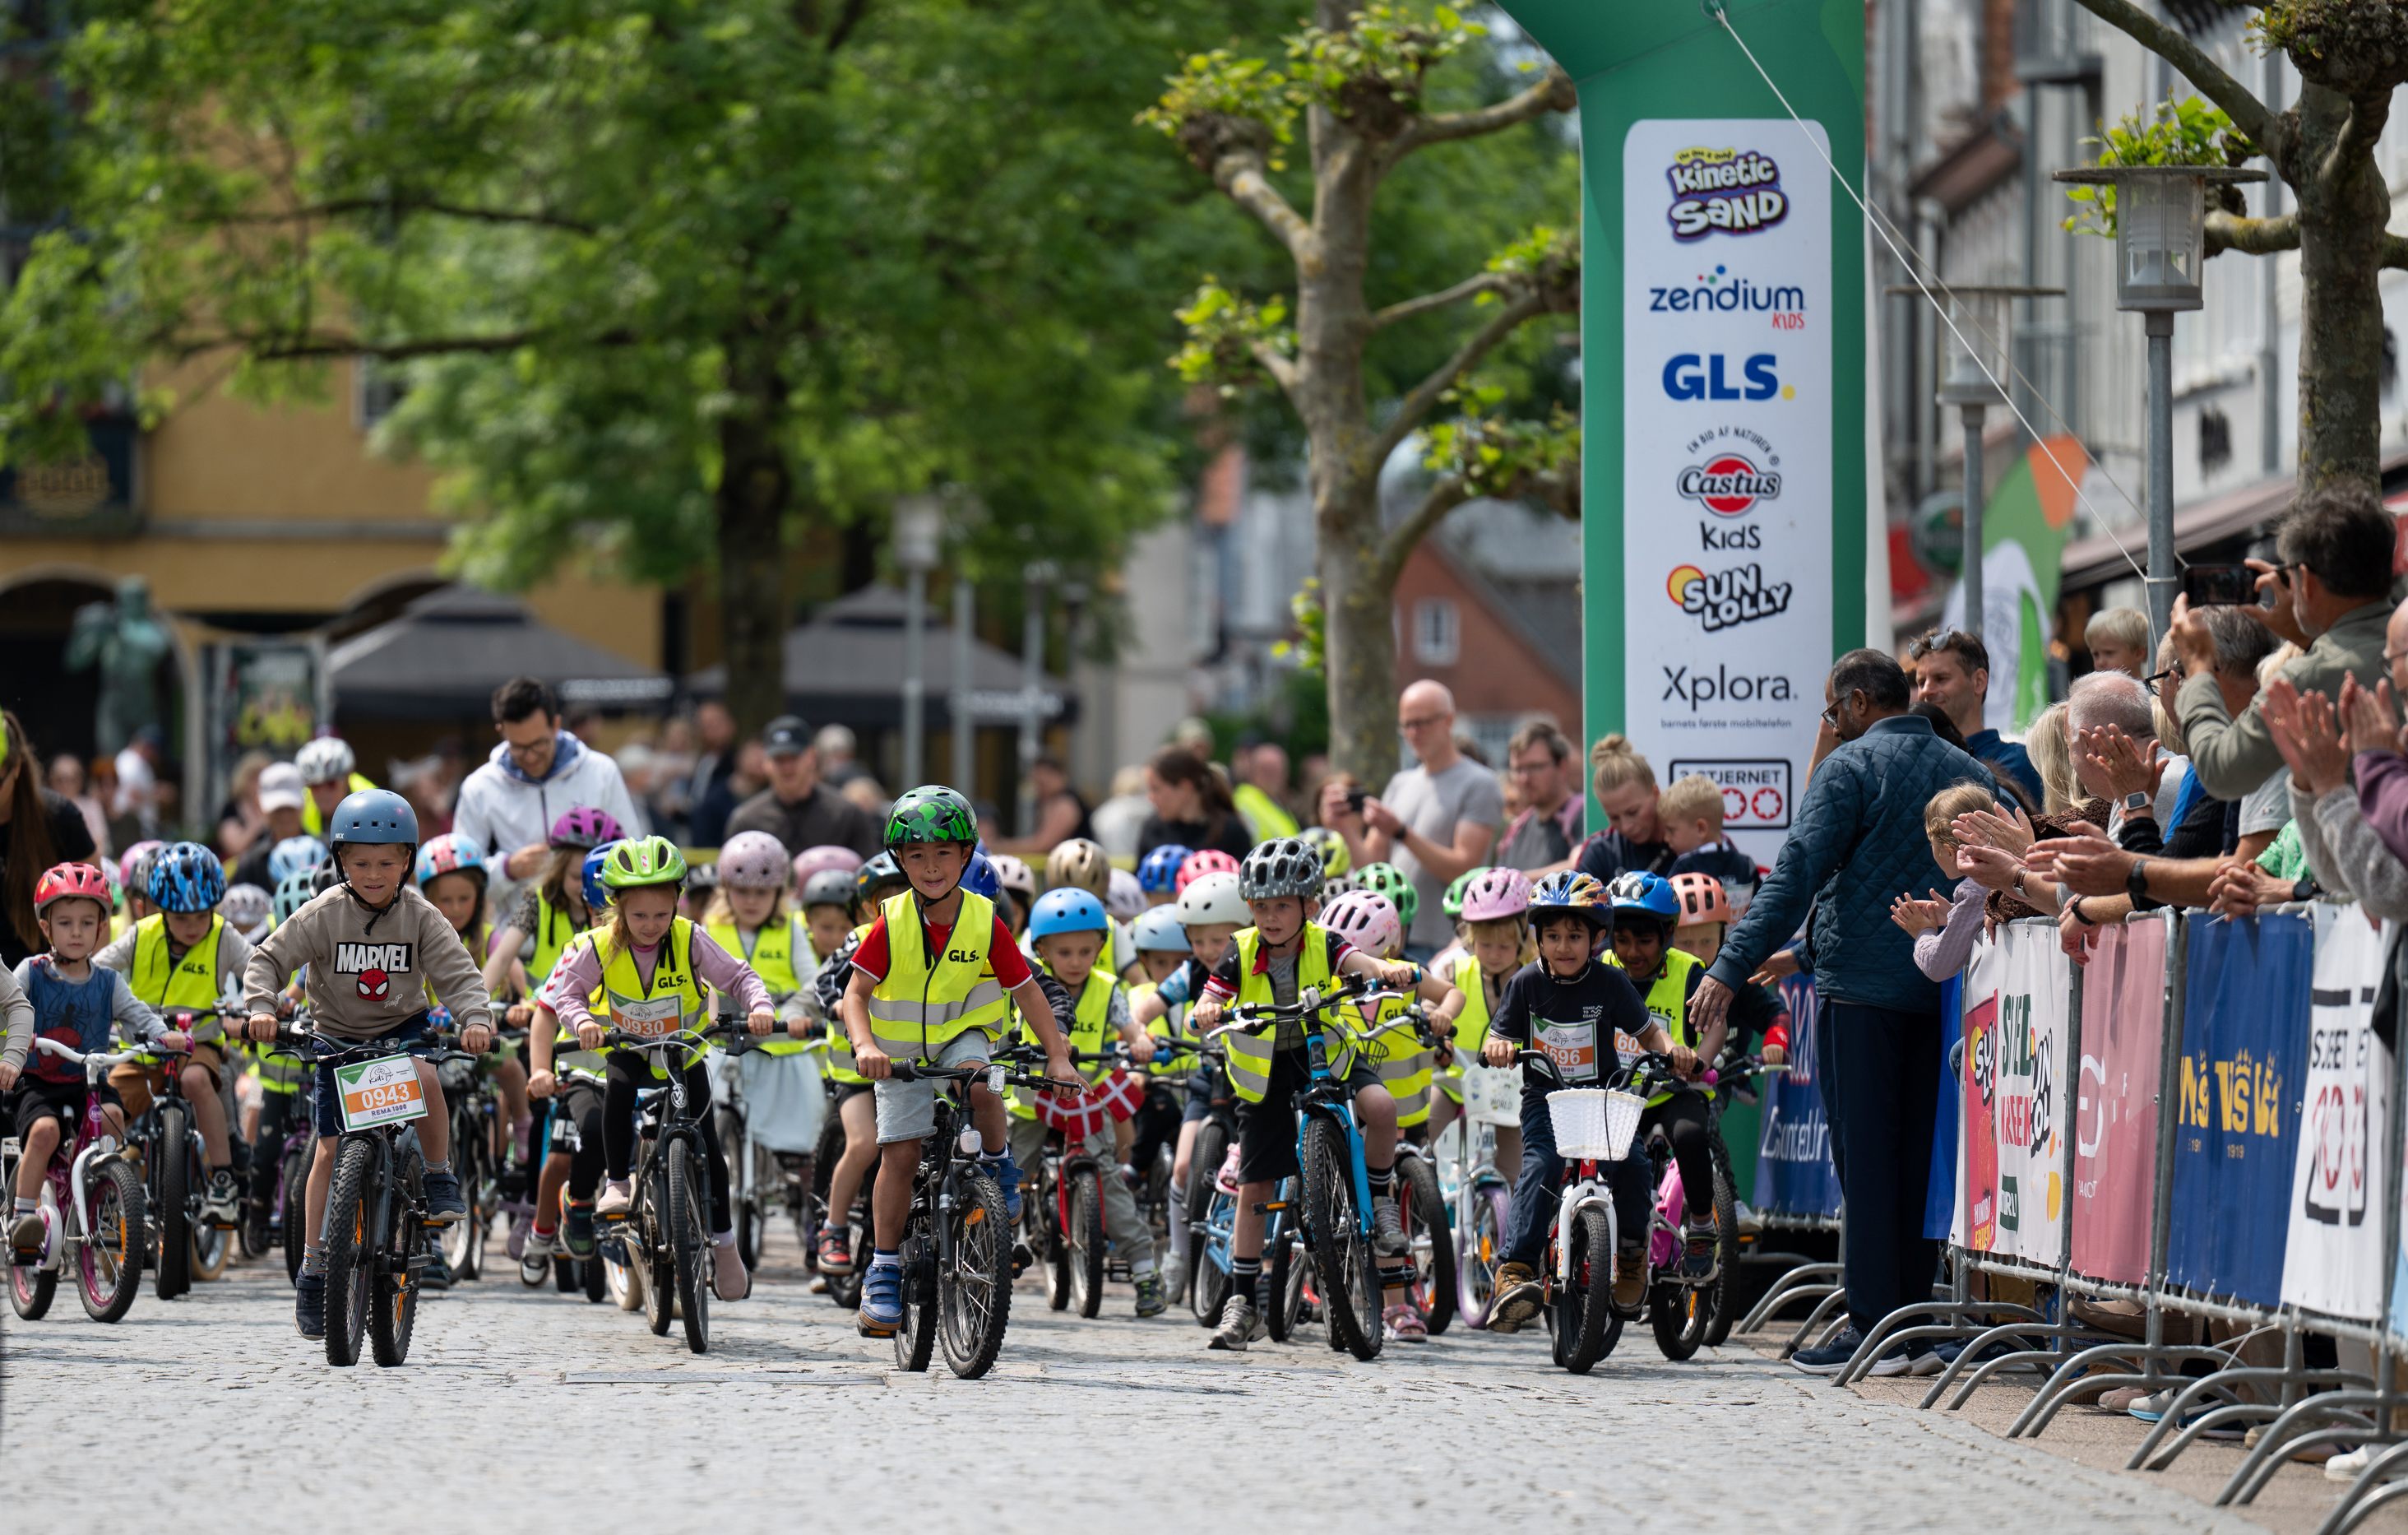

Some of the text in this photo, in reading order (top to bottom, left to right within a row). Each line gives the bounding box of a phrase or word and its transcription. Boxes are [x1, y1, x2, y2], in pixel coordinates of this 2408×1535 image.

[1649, 278, 1804, 312] zendium
[1771, 312, 1805, 330] KIDS
[1687, 425, 1772, 453] EN BID AF NATUREN
[1681, 471, 1778, 494] Castus
[1683, 563, 1762, 613] SUN
[1702, 582, 1792, 632] LOLLY
[1660, 717, 1792, 728] barnets første mobiltelefon
[336, 944, 410, 972] MARVEL
[948, 949, 980, 963] GLS.
[657, 974, 688, 989] GLS.
[622, 1016, 665, 1036] 0930
[1542, 1044, 1581, 1065] 1696
[361, 1083, 410, 1109] 0943
[371, 1104, 407, 1117] REMA 1000
[2227, 1143, 2244, 1159] 1919
